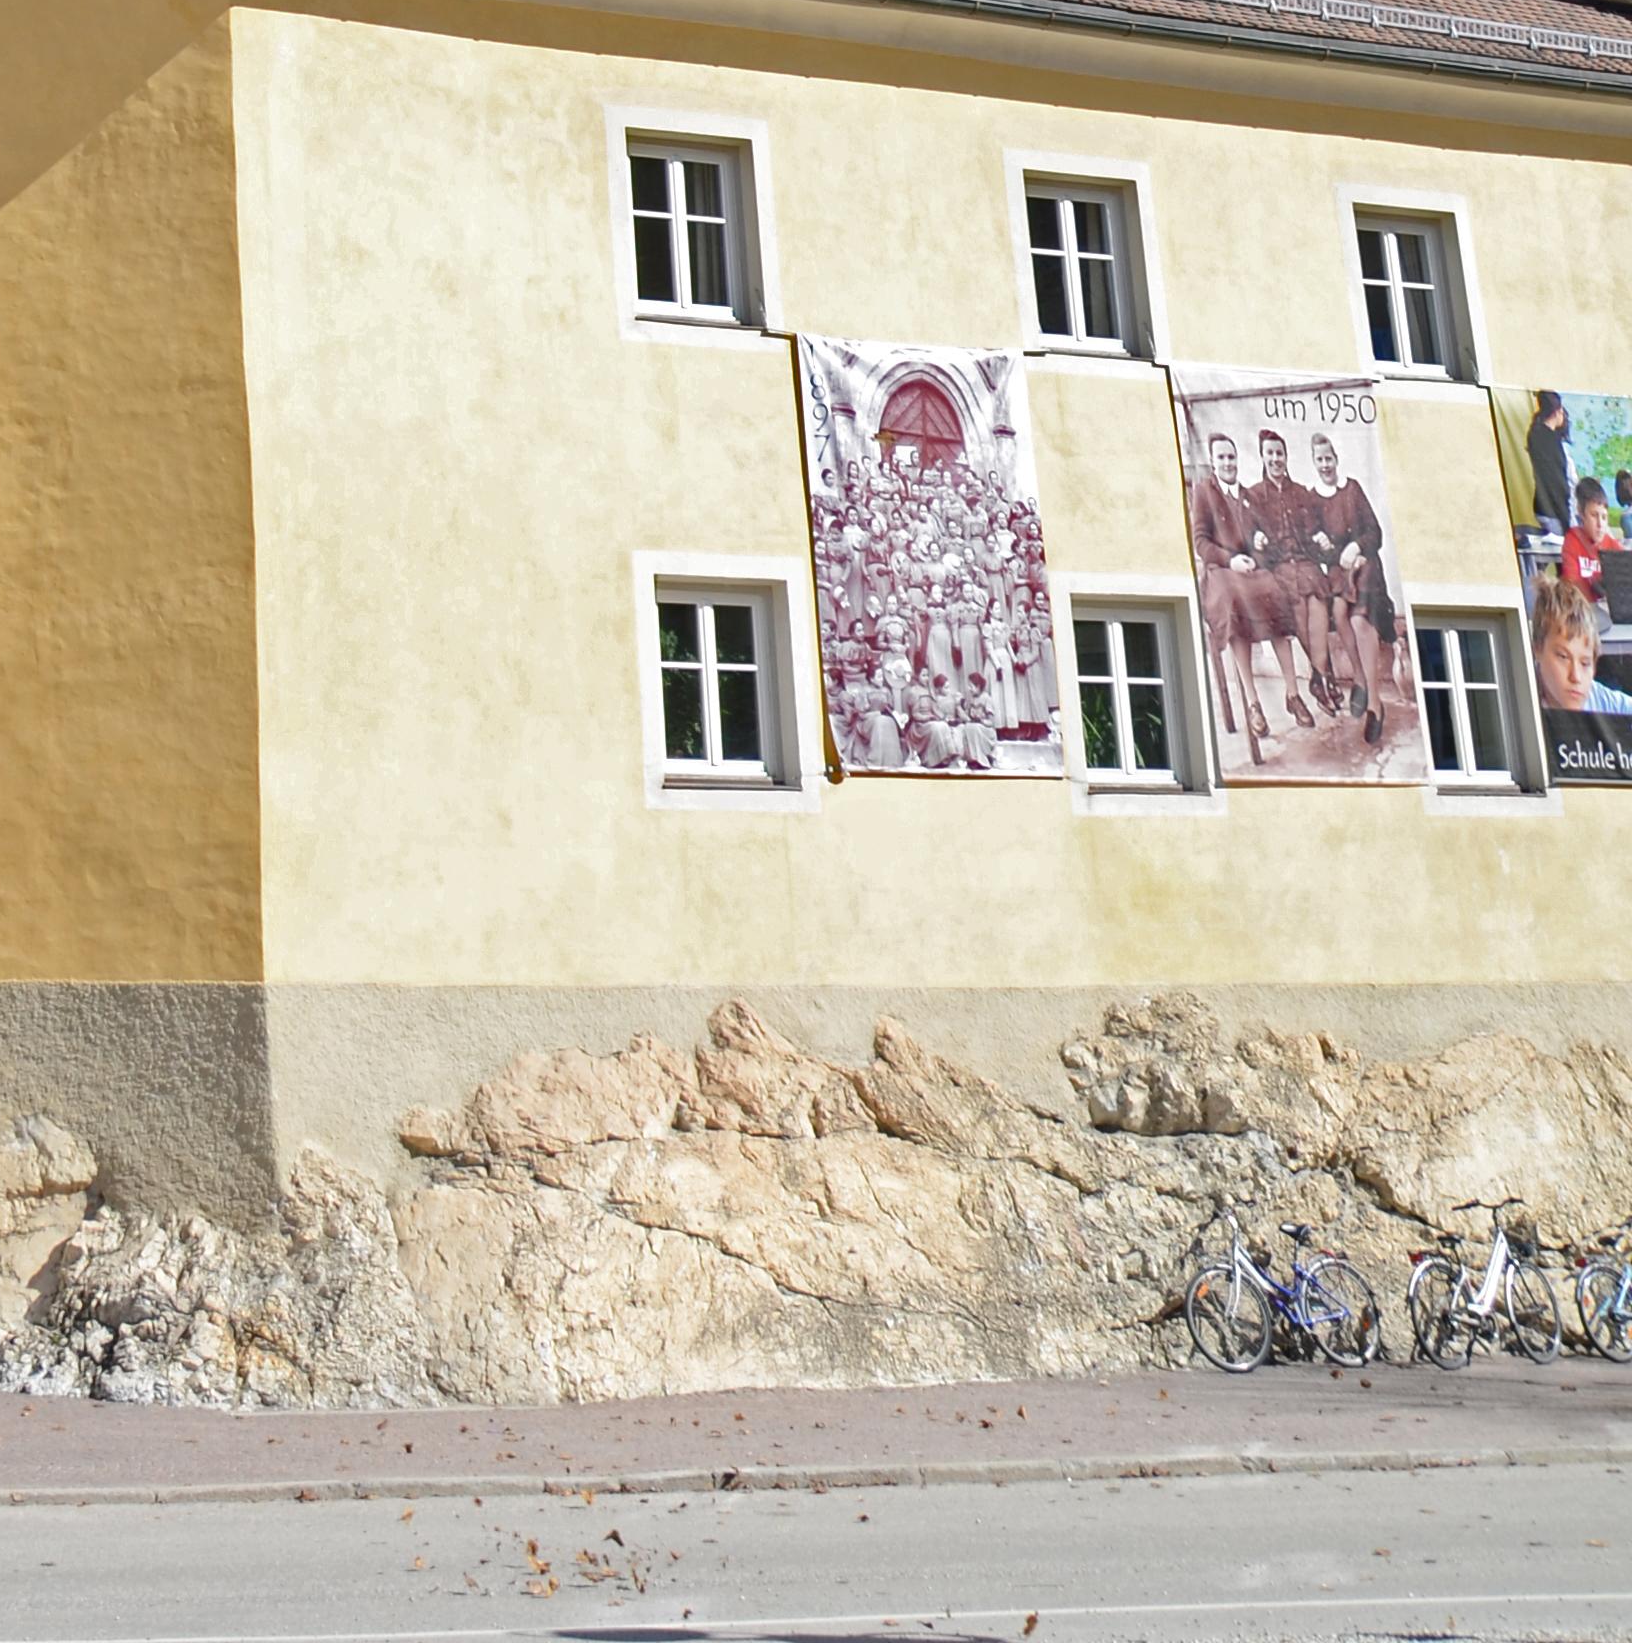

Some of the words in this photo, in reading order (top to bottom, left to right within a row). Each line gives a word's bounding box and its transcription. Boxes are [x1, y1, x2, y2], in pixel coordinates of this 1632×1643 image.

[1265, 397, 1306, 421] um
[1314, 391, 1377, 424] 1950
[1558, 740, 1616, 770] Schule
[1616, 742, 1632, 769] h
